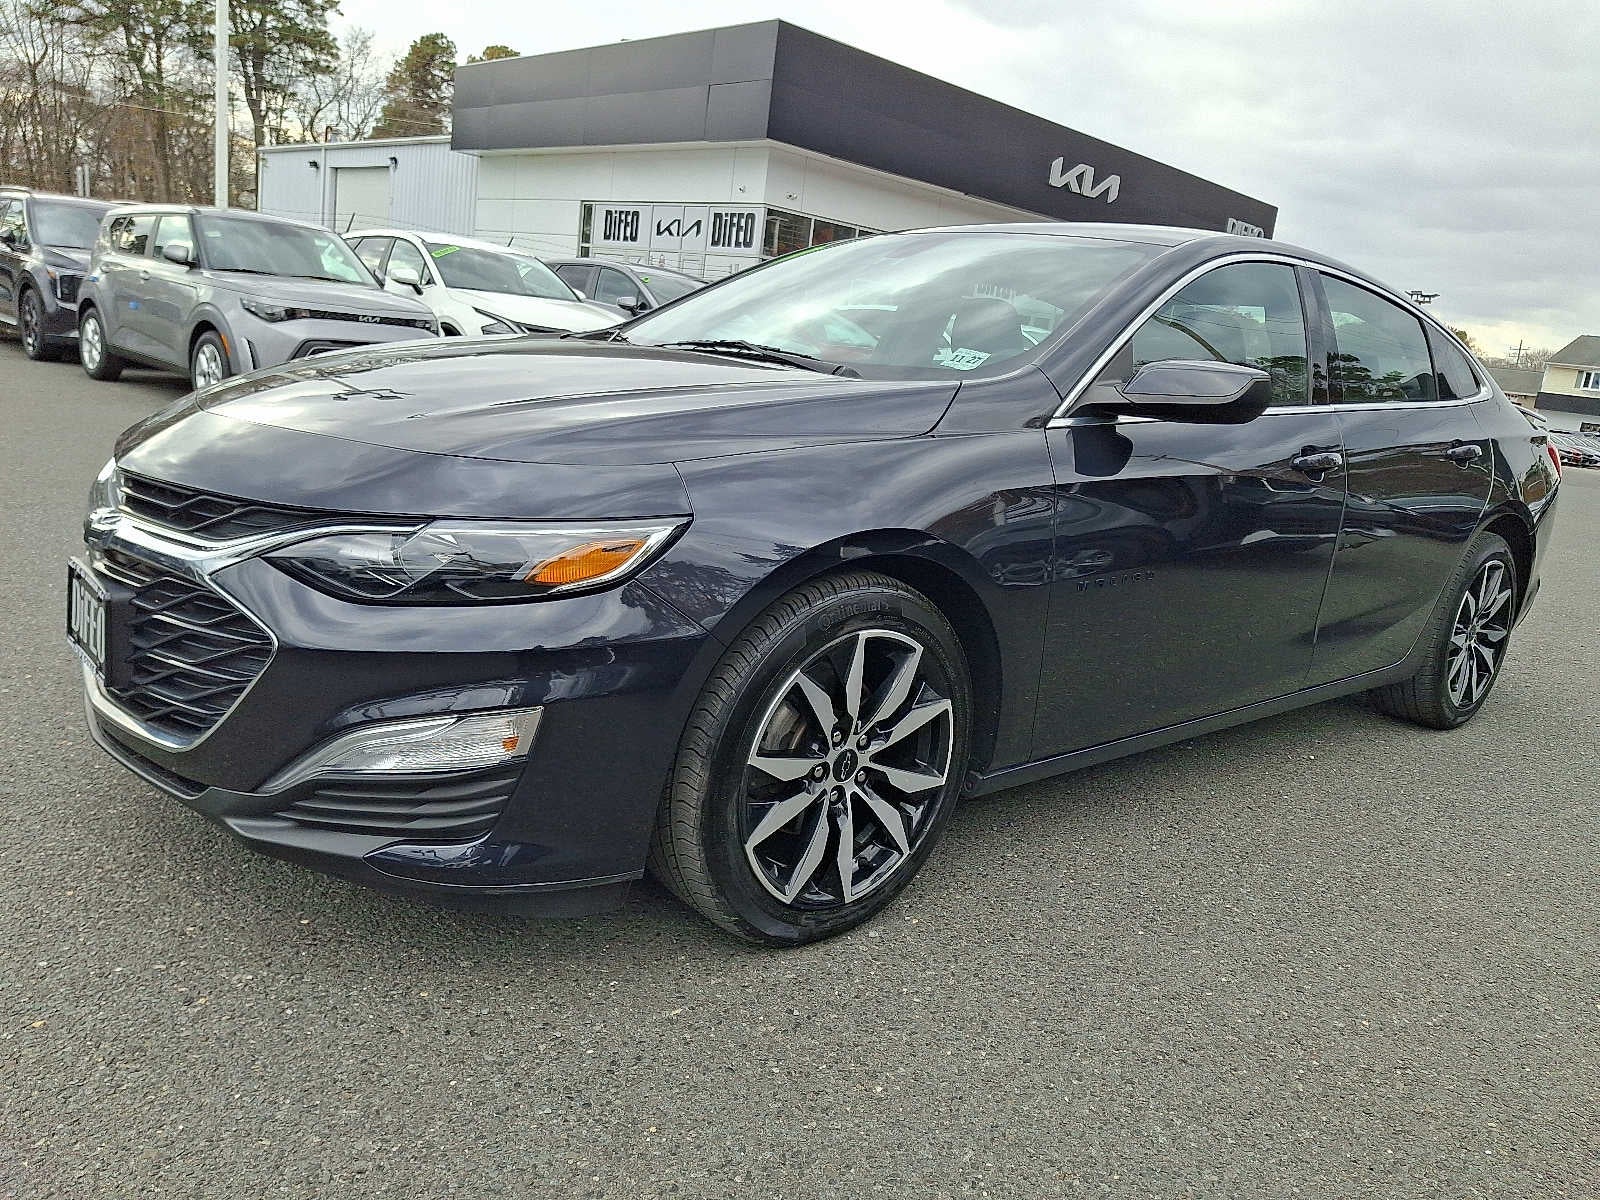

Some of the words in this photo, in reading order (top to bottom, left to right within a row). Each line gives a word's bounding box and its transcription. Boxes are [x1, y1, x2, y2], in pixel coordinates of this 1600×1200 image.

[1049, 157, 1121, 203] KIA
[604, 210, 640, 242] DiFEO
[656, 219, 702, 238] KIA
[711, 213, 756, 248] DiFEO
